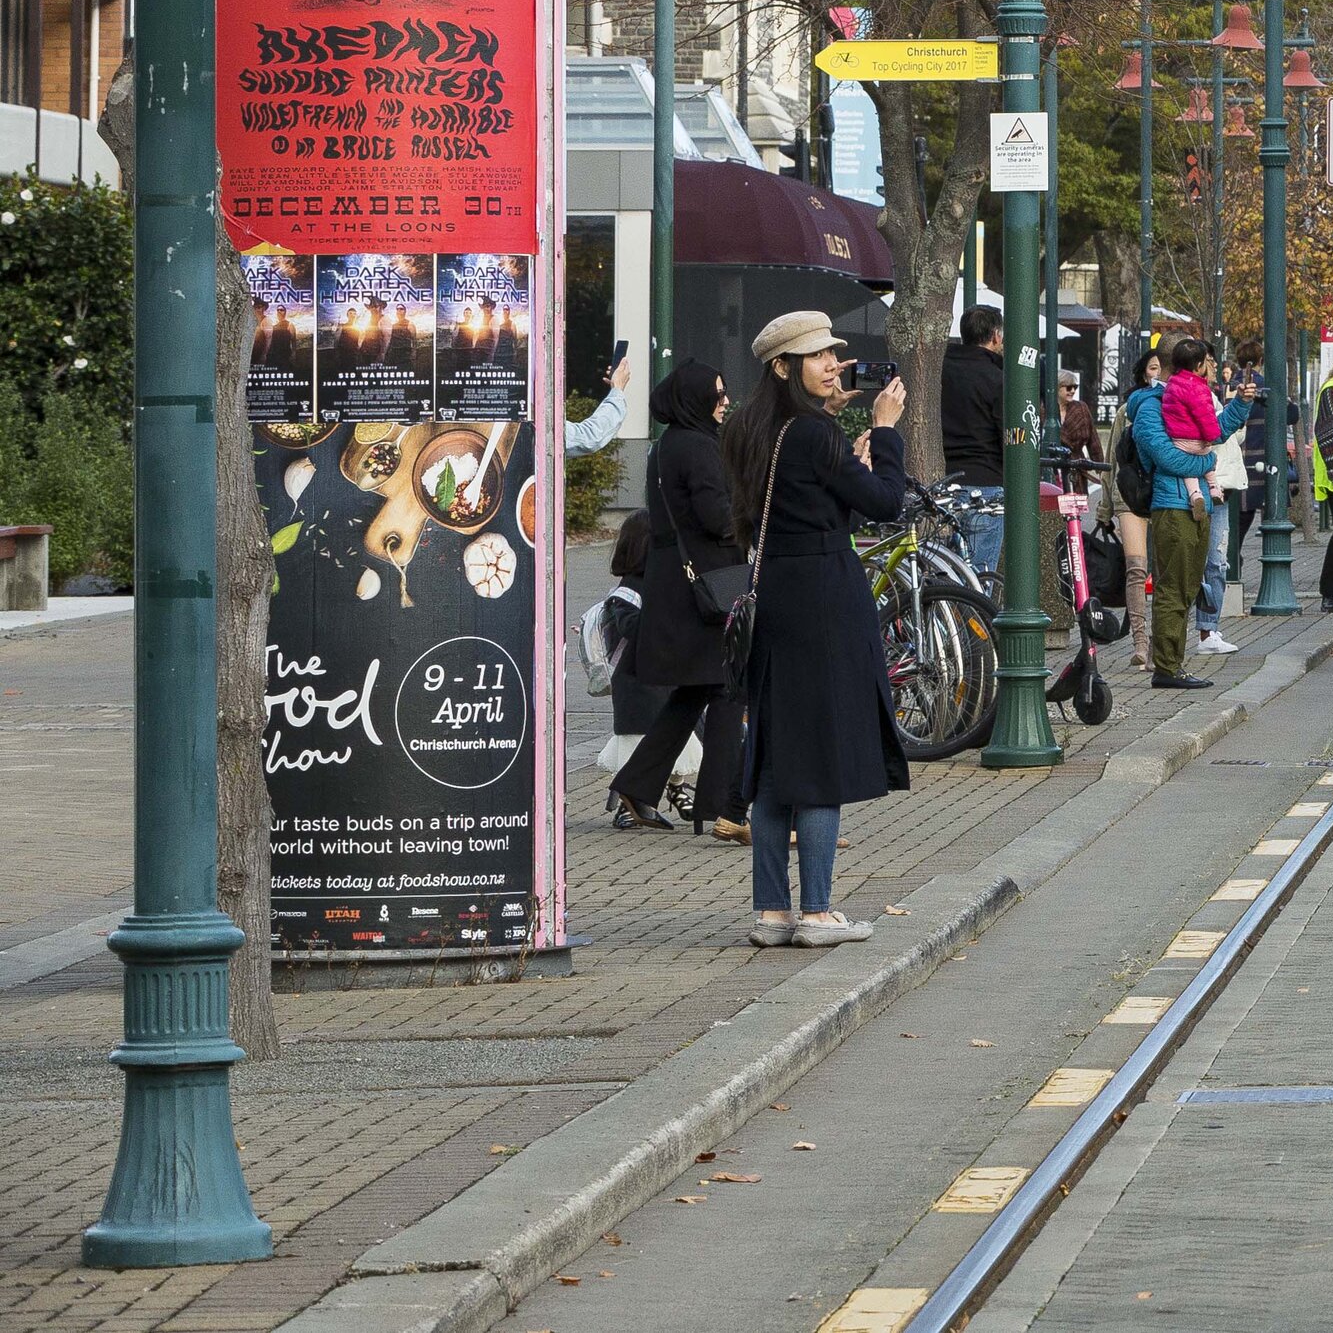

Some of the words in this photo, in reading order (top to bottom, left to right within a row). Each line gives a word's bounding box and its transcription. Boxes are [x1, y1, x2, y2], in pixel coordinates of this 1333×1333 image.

[906, 47, 968, 57] Christchurch
[872, 62, 889, 73] Top
[891, 61, 923, 73] Cycling
[926, 61, 944, 72] City
[946, 61, 967, 72] 2017
[295, 138, 315, 159] DR
[323, 136, 397, 160] BRUCE
[411, 134, 492, 160] RUSSELL
[232, 196, 441, 217] DECEMBER
[290, 222, 317, 233] AT
[330, 222, 372, 233] THE
[385, 222, 456, 233] LOONS
[244, 267, 281, 279] ARK
[345, 267, 400, 279] DARK
[463, 266, 505, 278] DARK
[1070, 535, 1082, 582] Flamingo
[423, 664, 445, 691] 9
[473, 664, 505, 690] 11
[431, 696, 505, 729] April
[262, 730, 352, 773] how
[410, 737, 487, 751] Christchurch
[488, 737, 517, 749] Arena
[294, 816, 340, 831] taste
[346, 815, 394, 831] buds
[400, 817, 423, 831] on
[430, 817, 440, 829] a
[446, 814, 475, 832] trip
[480, 811, 528, 828] around
[321, 838, 393, 854] without
[400, 837, 463, 855] leaving
[468, 835, 510, 852] town!
[271, 875, 321, 888] tickets
[326, 875, 373, 891] today
[377, 875, 395, 888] at
[395, 873, 506, 891] foodshow.co.nz
[325, 909, 361, 919] UTAH
